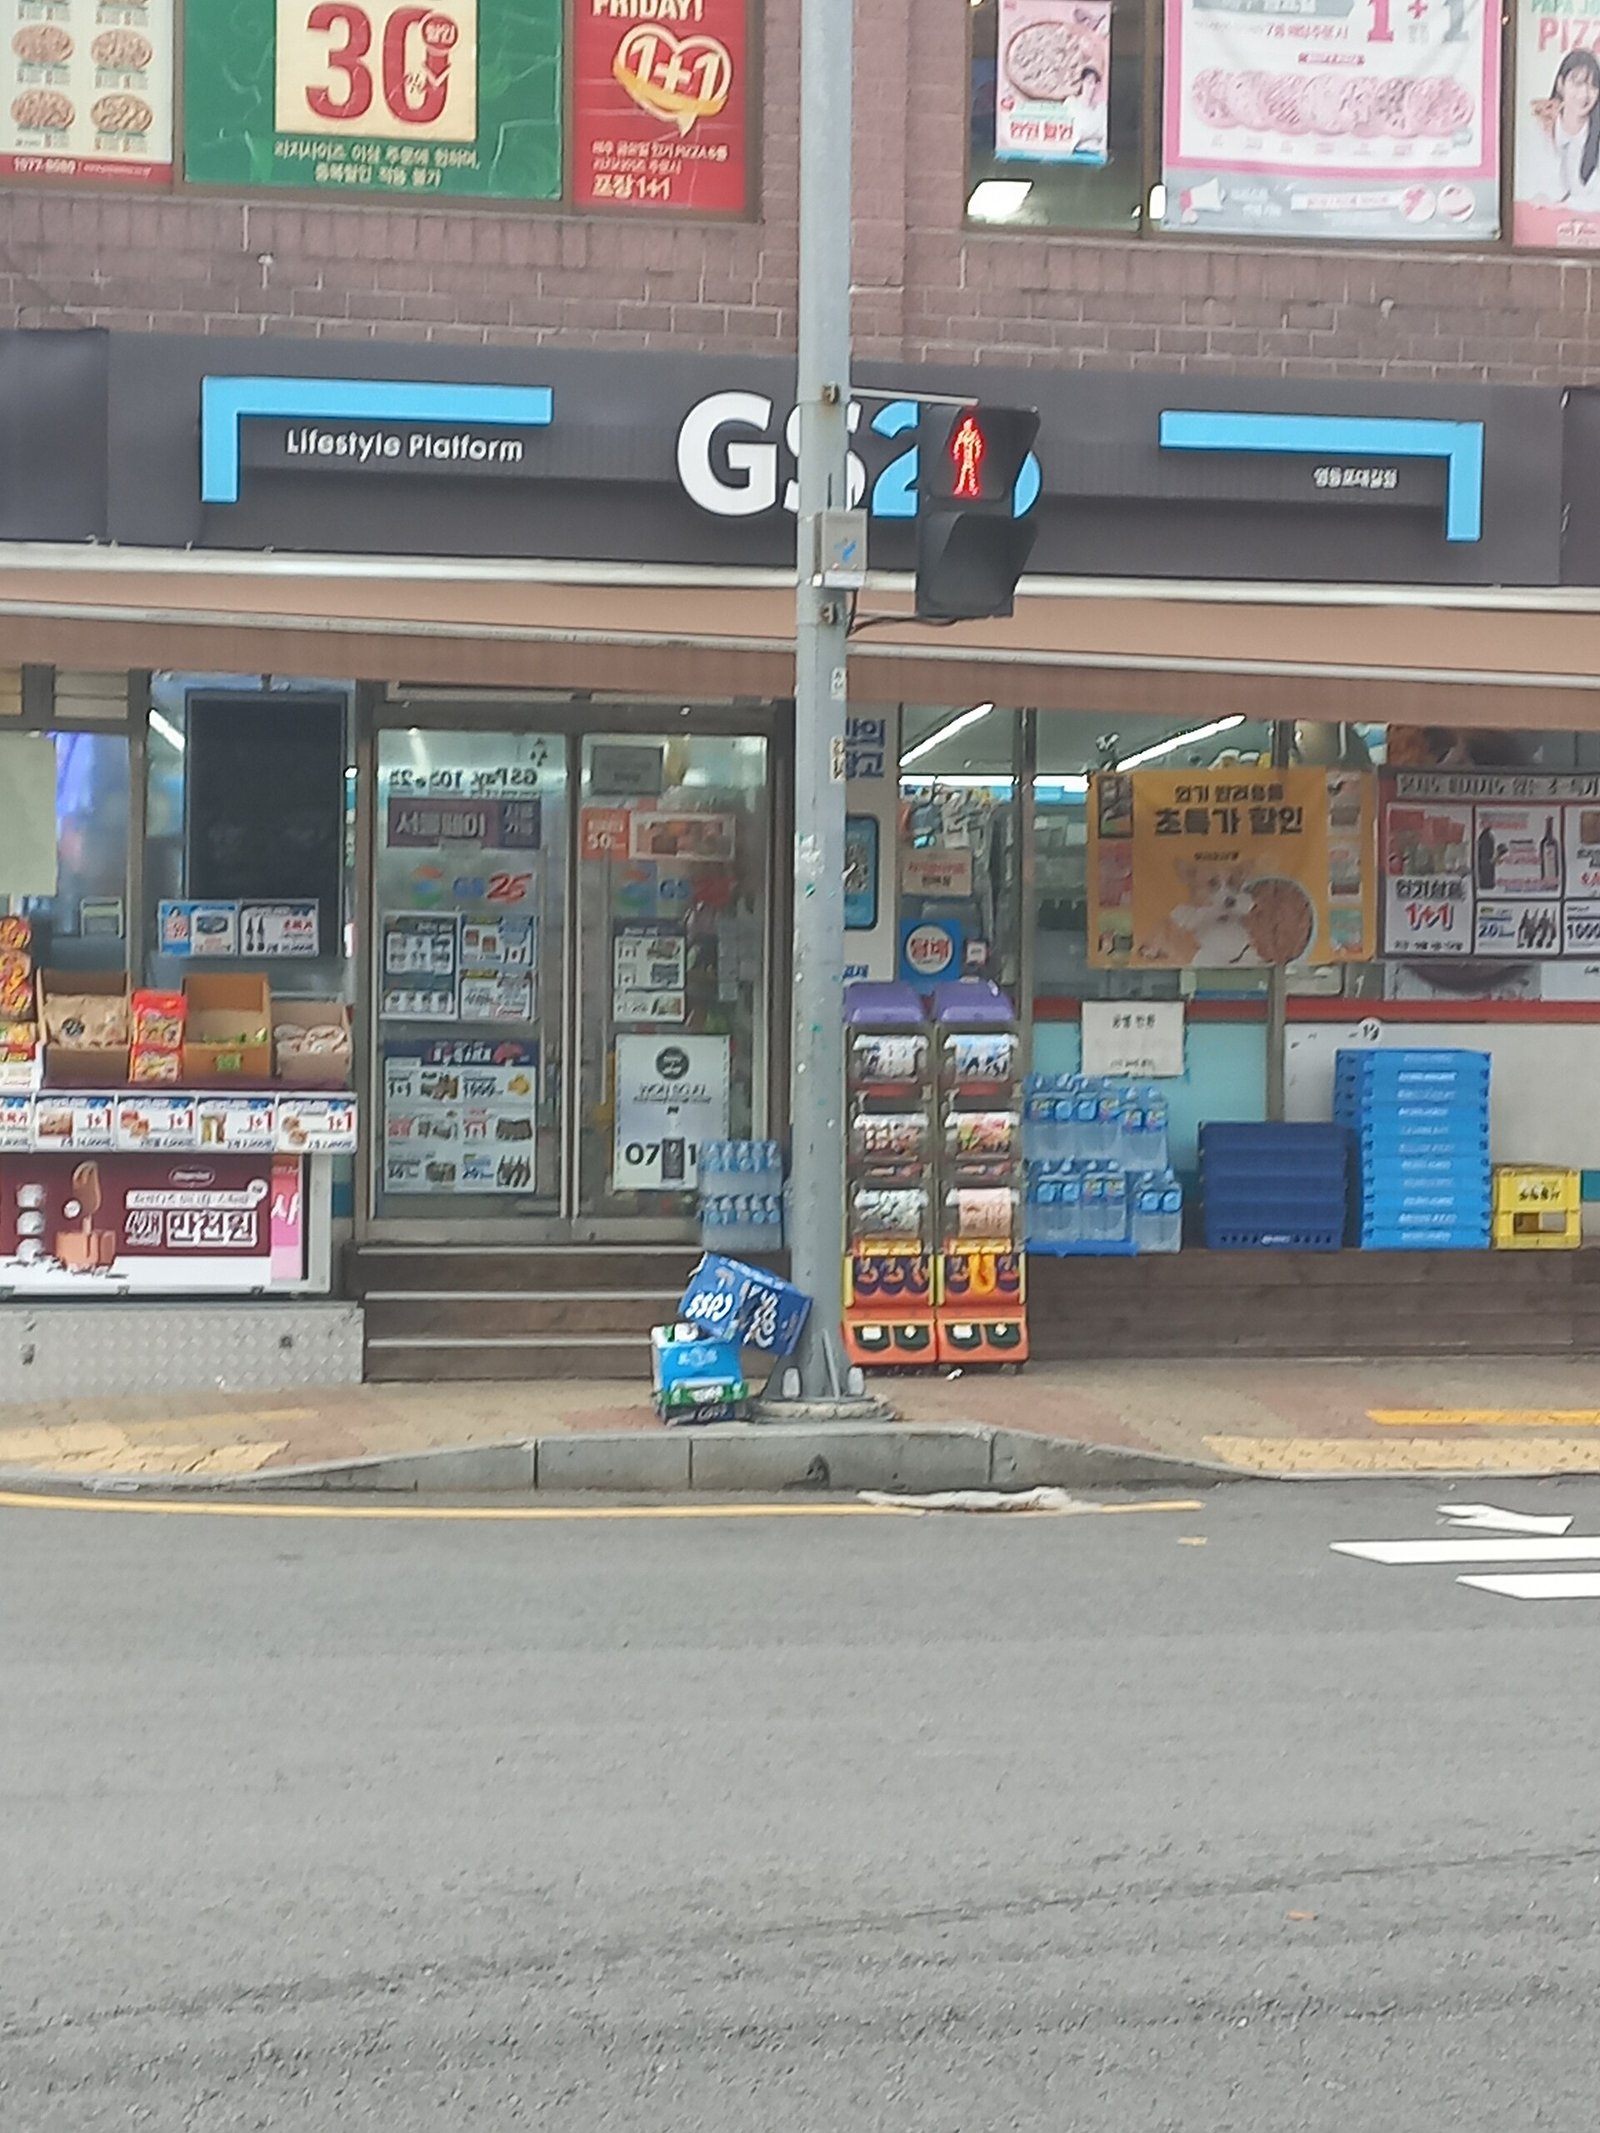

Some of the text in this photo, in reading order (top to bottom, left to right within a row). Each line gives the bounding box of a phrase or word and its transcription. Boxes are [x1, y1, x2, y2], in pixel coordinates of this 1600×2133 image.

[286, 428, 524, 463] Lifestyle Platform
[677, 391, 1042, 519] G2
